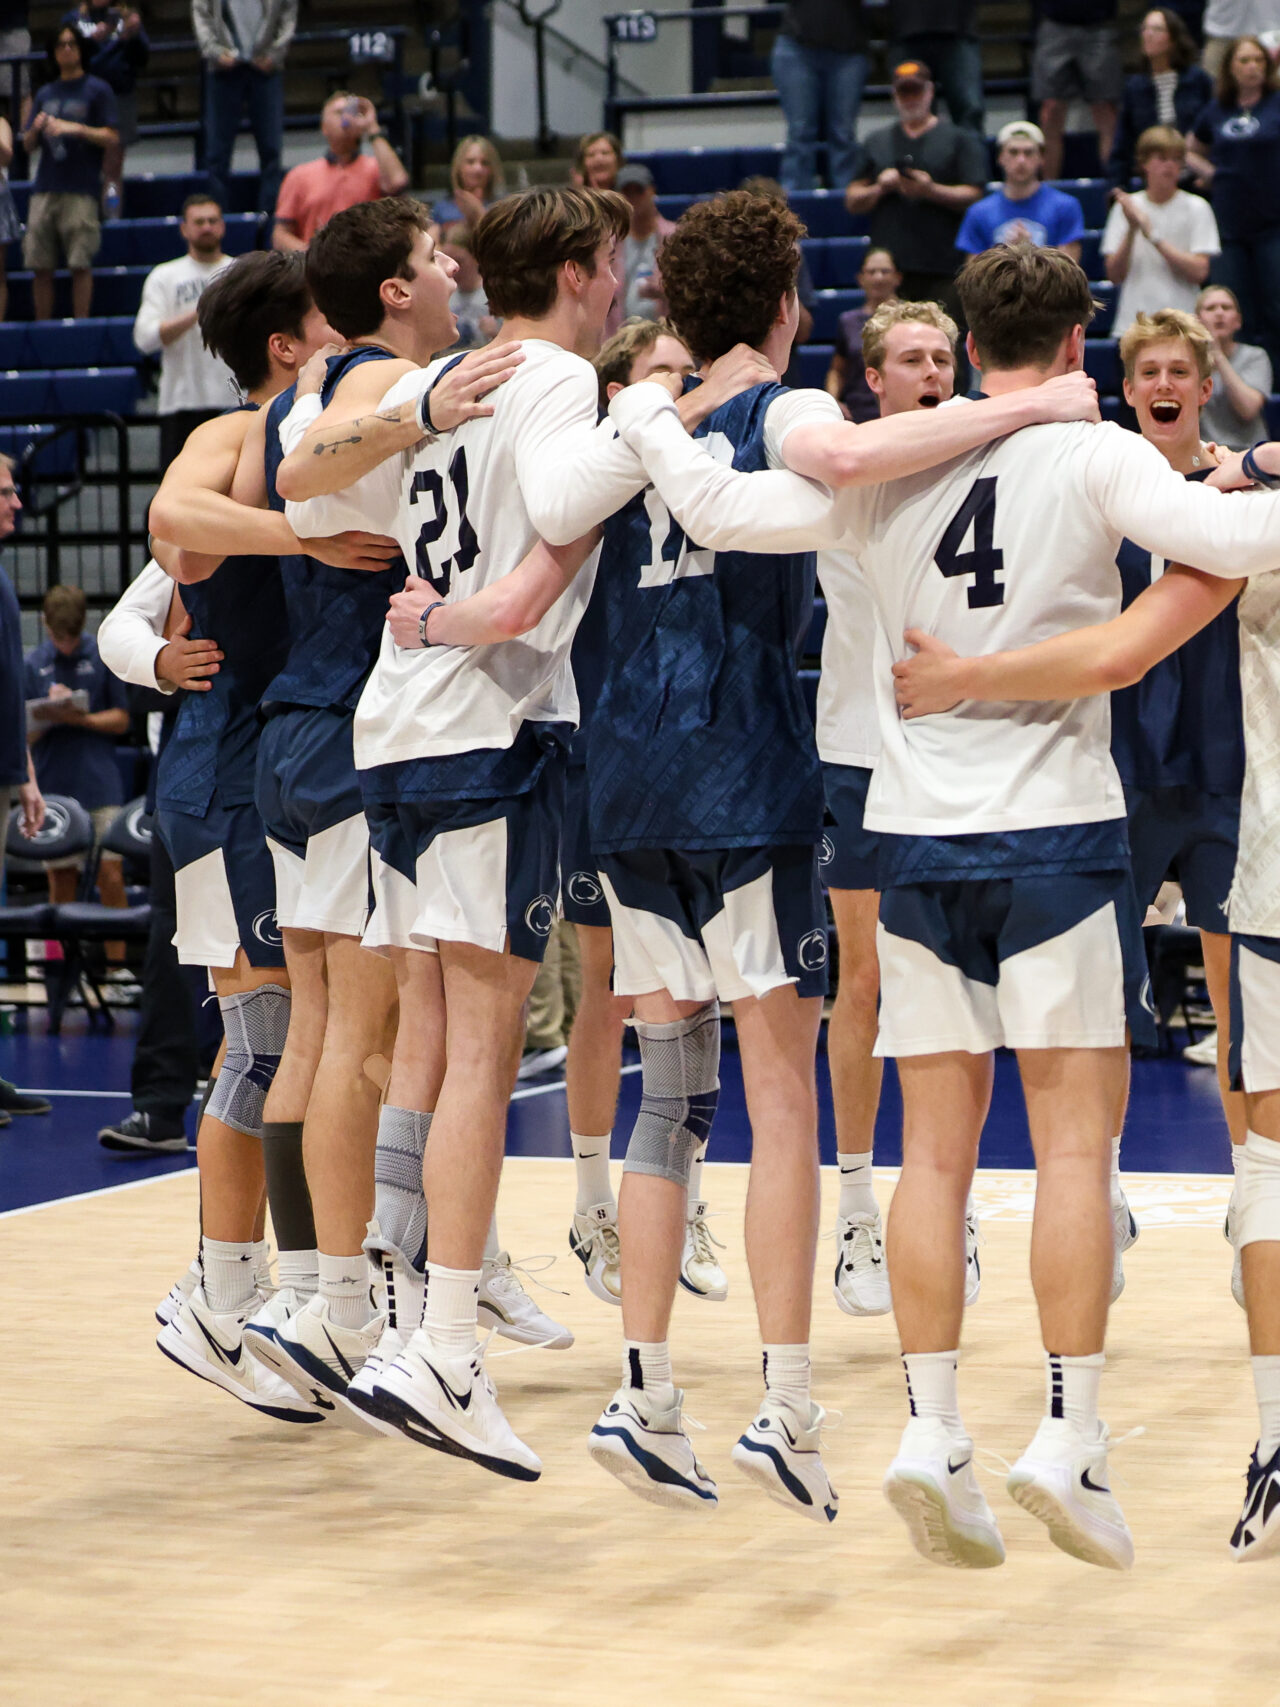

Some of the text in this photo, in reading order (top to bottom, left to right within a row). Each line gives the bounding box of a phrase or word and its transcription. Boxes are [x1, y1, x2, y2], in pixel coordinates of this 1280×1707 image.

[349, 31, 387, 56] 112
[616, 15, 656, 39] 113
[410, 445, 482, 599] 21
[933, 475, 1006, 610] 4
